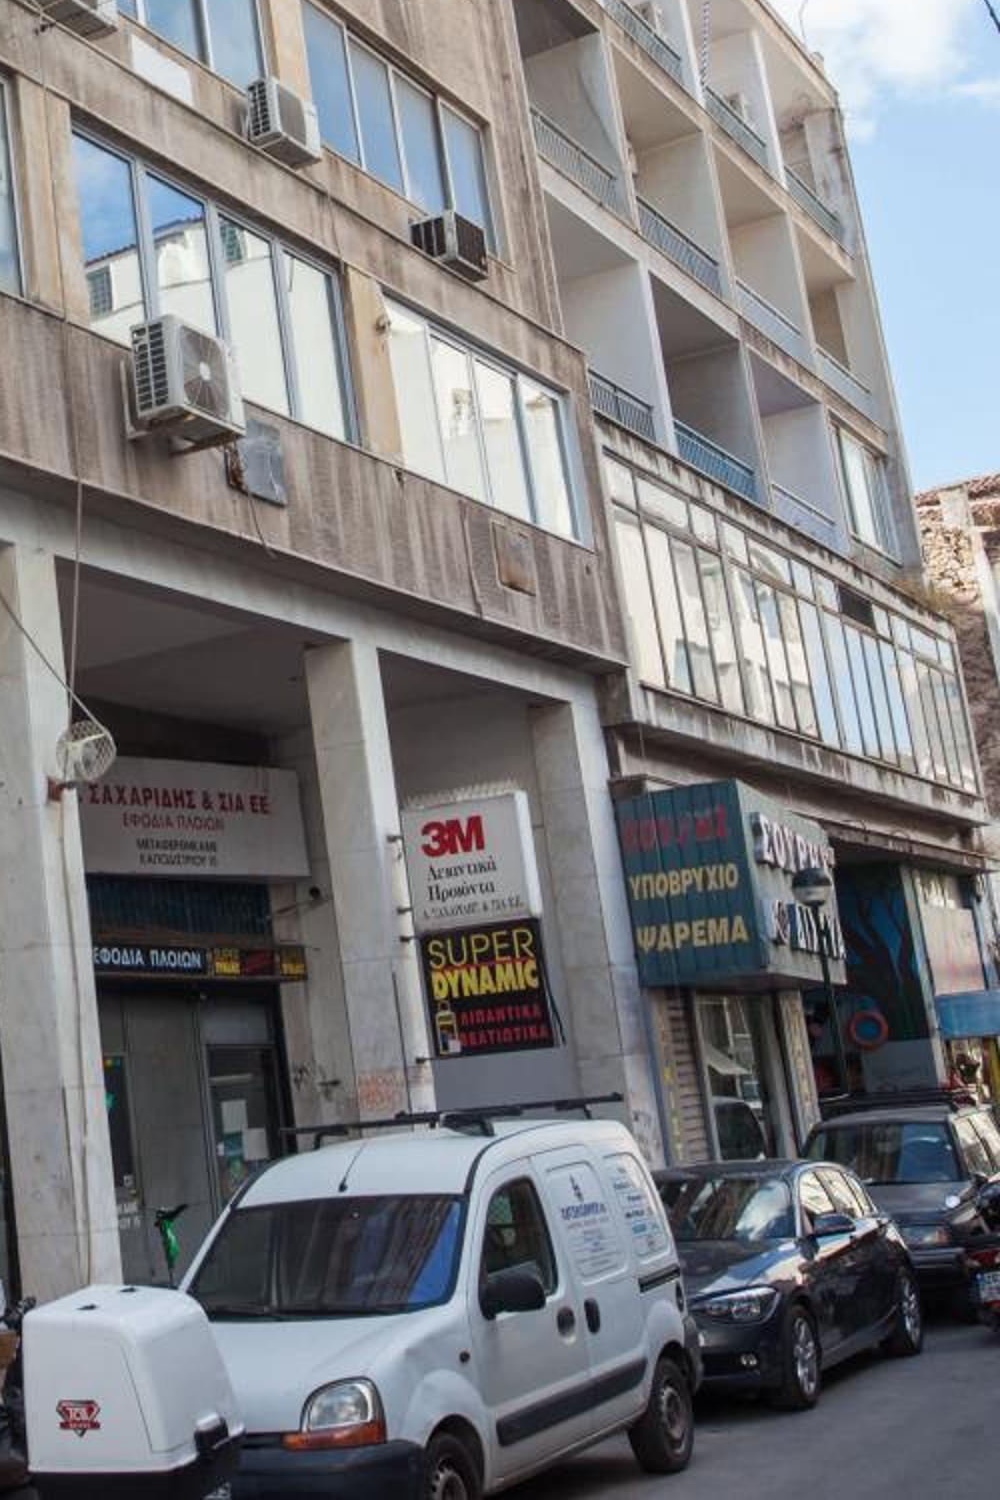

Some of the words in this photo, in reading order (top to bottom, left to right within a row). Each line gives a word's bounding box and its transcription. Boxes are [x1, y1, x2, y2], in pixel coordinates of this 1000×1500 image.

[201, 791, 216, 811] &
[421, 815, 485, 858] 3M
[629, 863, 739, 901] ΥΠΟΒΡΥΧΙΟ
[428, 927, 535, 970] SUPER
[636, 915, 750, 953] ΨΑΡΕΜΑ
[150, 949, 203, 968] ΠΛΟΙΩΝ
[431, 958, 540, 1001] DYNAMIC
